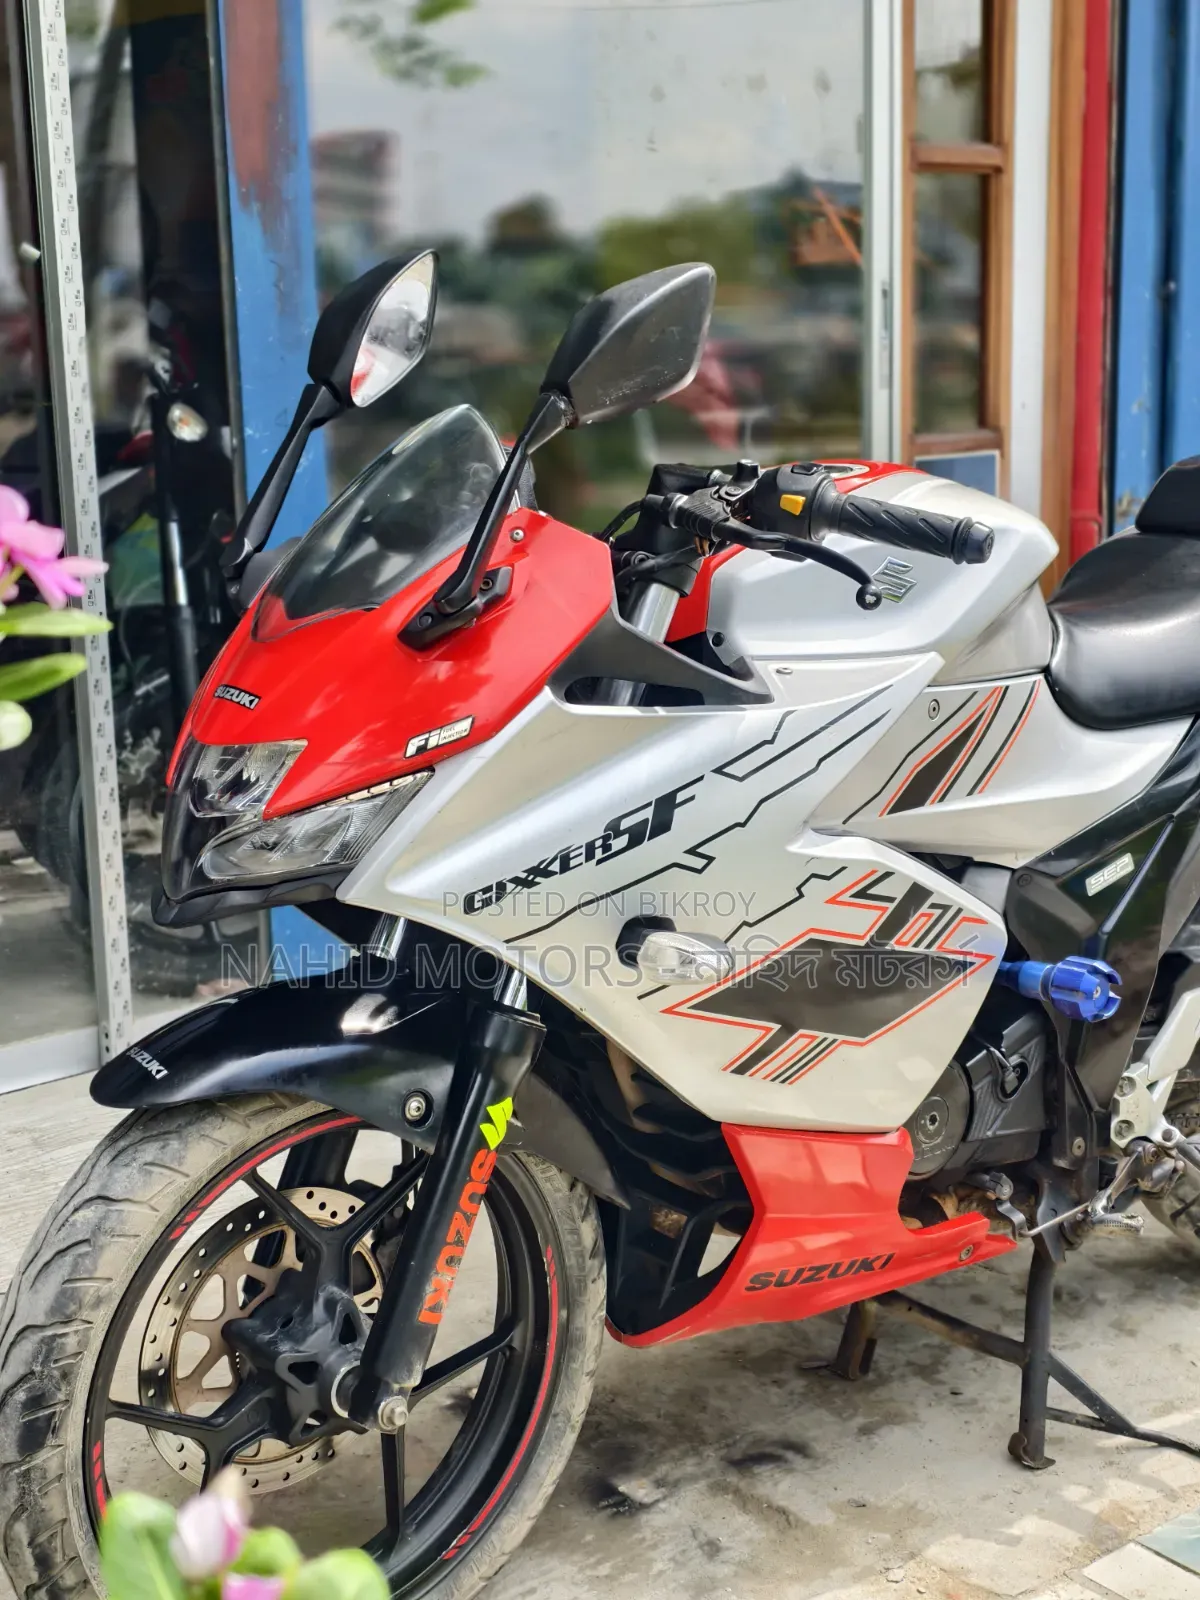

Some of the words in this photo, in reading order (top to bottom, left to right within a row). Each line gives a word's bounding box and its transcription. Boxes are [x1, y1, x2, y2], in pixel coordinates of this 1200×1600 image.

[214, 685, 260, 710] SUZUKI
[463, 832, 613, 915] GIXXER
[595, 774, 705, 866] SF
[1090, 856, 1129, 889] SEP
[126, 1046, 168, 1079] SUZUKI
[418, 1149, 497, 1324] SUZUKI
[744, 1252, 896, 1292] SUZUKI
